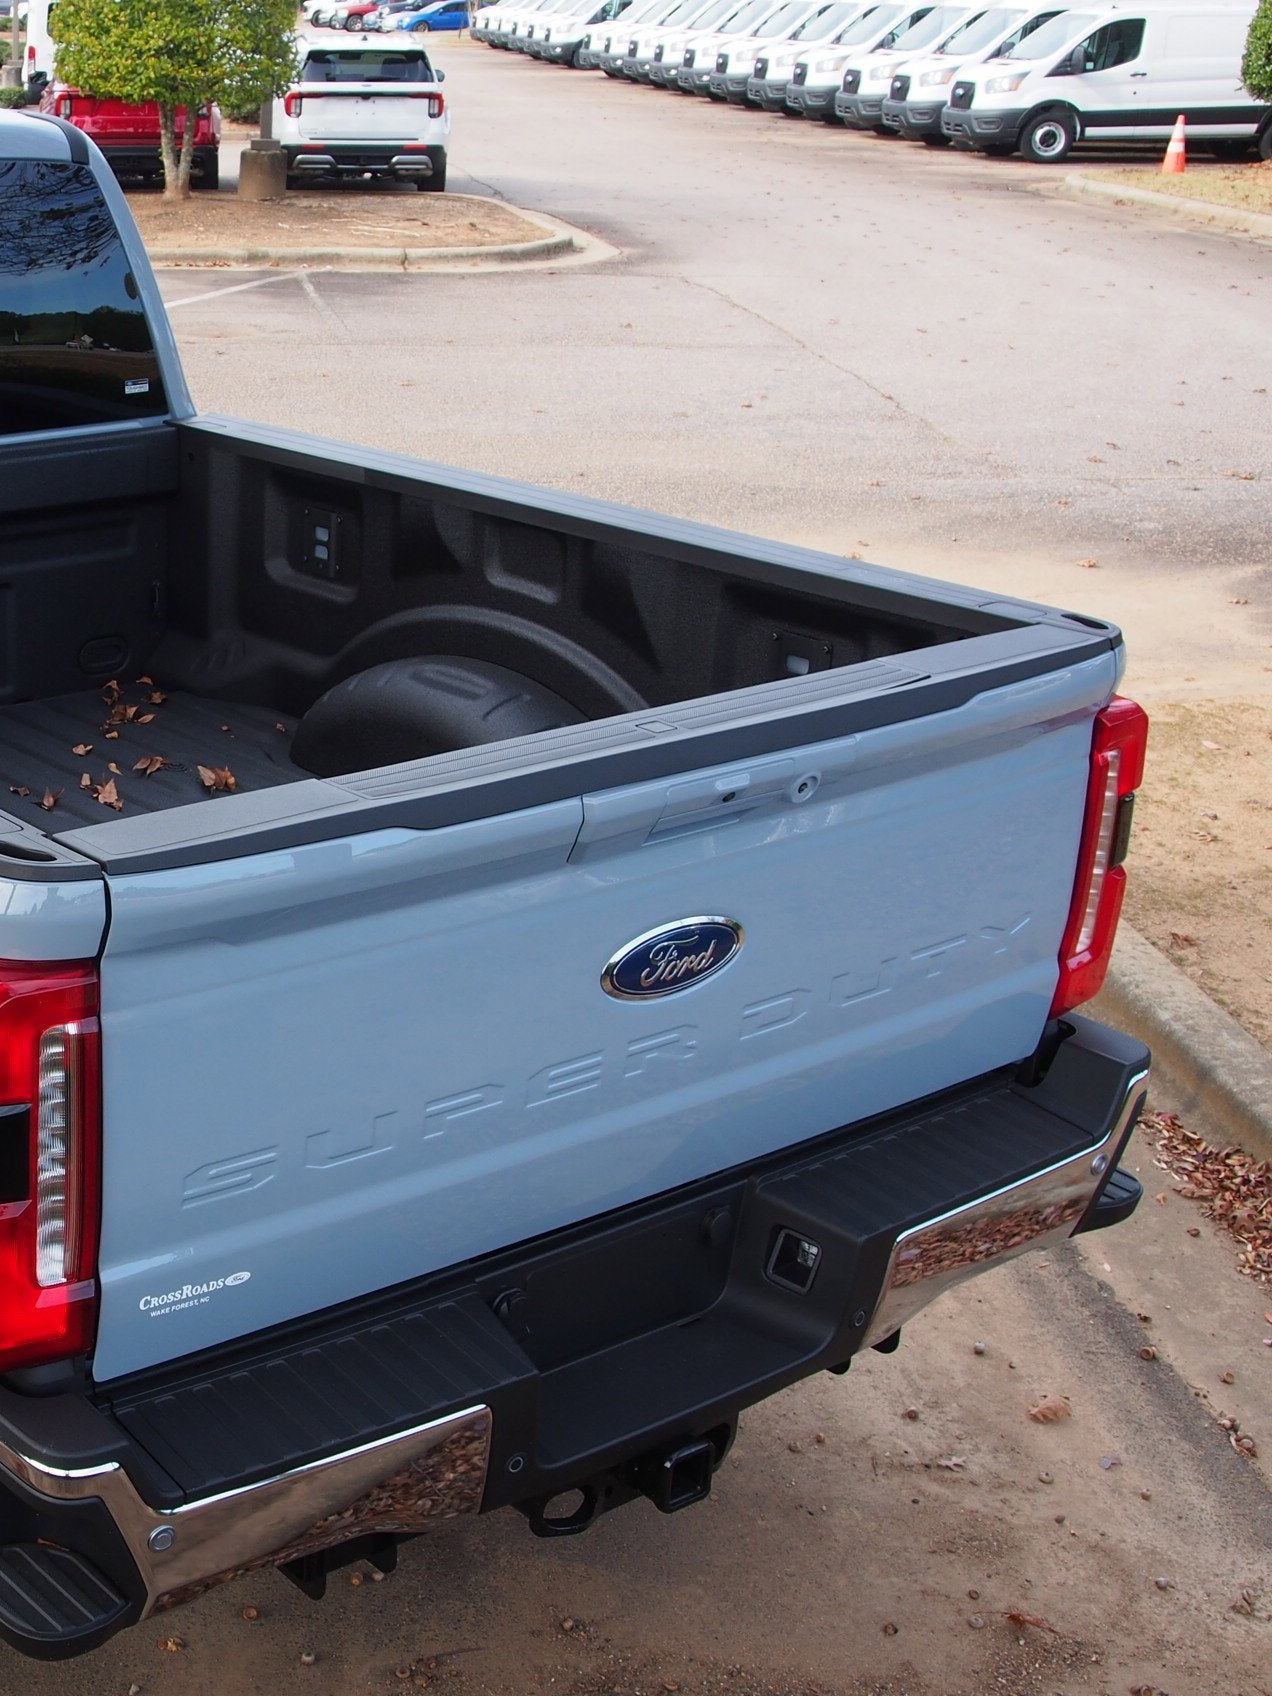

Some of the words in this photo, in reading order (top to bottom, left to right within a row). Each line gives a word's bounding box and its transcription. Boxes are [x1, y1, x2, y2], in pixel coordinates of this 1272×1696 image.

[639, 934, 718, 988] Ford
[182, 1023, 700, 1210] SUPER
[739, 910, 1033, 1041] DUTY
[150, 1306, 170, 1317] WAKE
